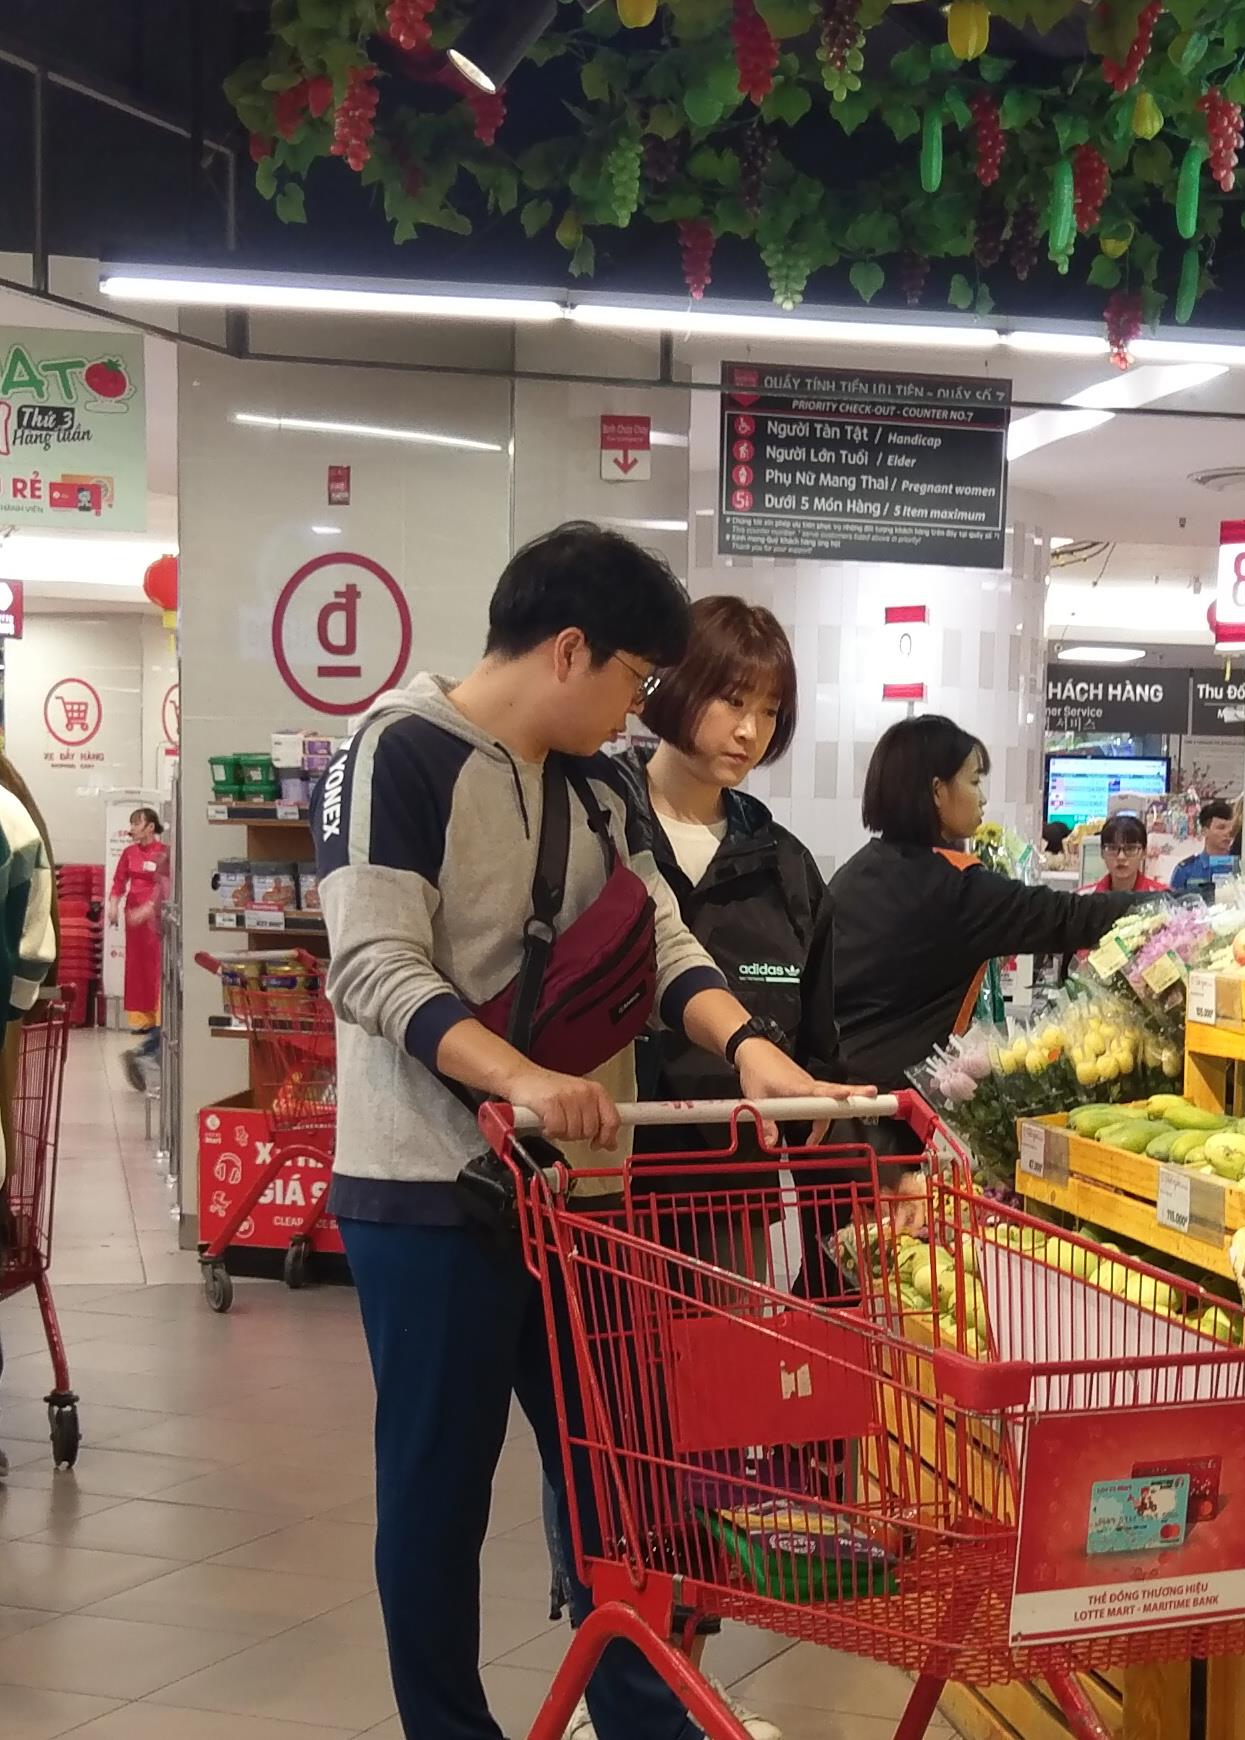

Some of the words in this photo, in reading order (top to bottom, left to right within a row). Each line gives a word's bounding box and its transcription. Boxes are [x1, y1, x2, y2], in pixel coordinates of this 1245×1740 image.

[62, 410, 73, 428] 3
[792, 399, 838, 412] PRIORITY
[840, 402, 896, 416] CHECK-OUT
[902, 406, 951, 420] COUNTER
[13, 428, 52, 450] Hàng
[767, 420, 810, 438] Người
[844, 424, 869, 444] Tật
[887, 431, 942, 449] Handicap
[766, 444, 806, 463] Người
[810, 447, 838, 465] Lớn
[840, 448, 869, 466] Tuổi
[887, 454, 917, 468] Elder
[12, 470, 42, 499] RẺ
[765, 468, 792, 488] Phụ
[795, 470, 816, 487] Nữ
[818, 472, 857, 492] Mang
[859, 474, 888, 491] Thai
[901, 479, 953, 496] Pregnant
[955, 484, 996, 497] women
[765, 493, 796, 510] Dưới
[800, 496, 809, 511] 5
[813, 497, 843, 512] Món
[846, 498, 881, 518] Hàng
[893, 504, 902, 517] 5
[929, 508, 986, 522] maximum
[1048, 678, 1103, 702] HÁCH
[1108, 679, 1164, 703] HÀNG
[1197, 683, 1223, 700] Thu
[1226, 682, 1245, 701] Đổ
[1064, 705, 1103, 718] Service
[322, 754, 348, 842] YONEX
[738, 963, 784, 976] adidas
[1088, 1592, 1107, 1606] THẺ
[1142, 1585, 1184, 1600] THƯƠNG
[1185, 1581, 1209, 1596] HIỆU
[1074, 1607, 1105, 1622] LOTTE
[1107, 1605, 1135, 1618] MART
[1143, 1599, 1190, 1613] MARITIME
[1192, 1594, 1219, 1608] BANK
